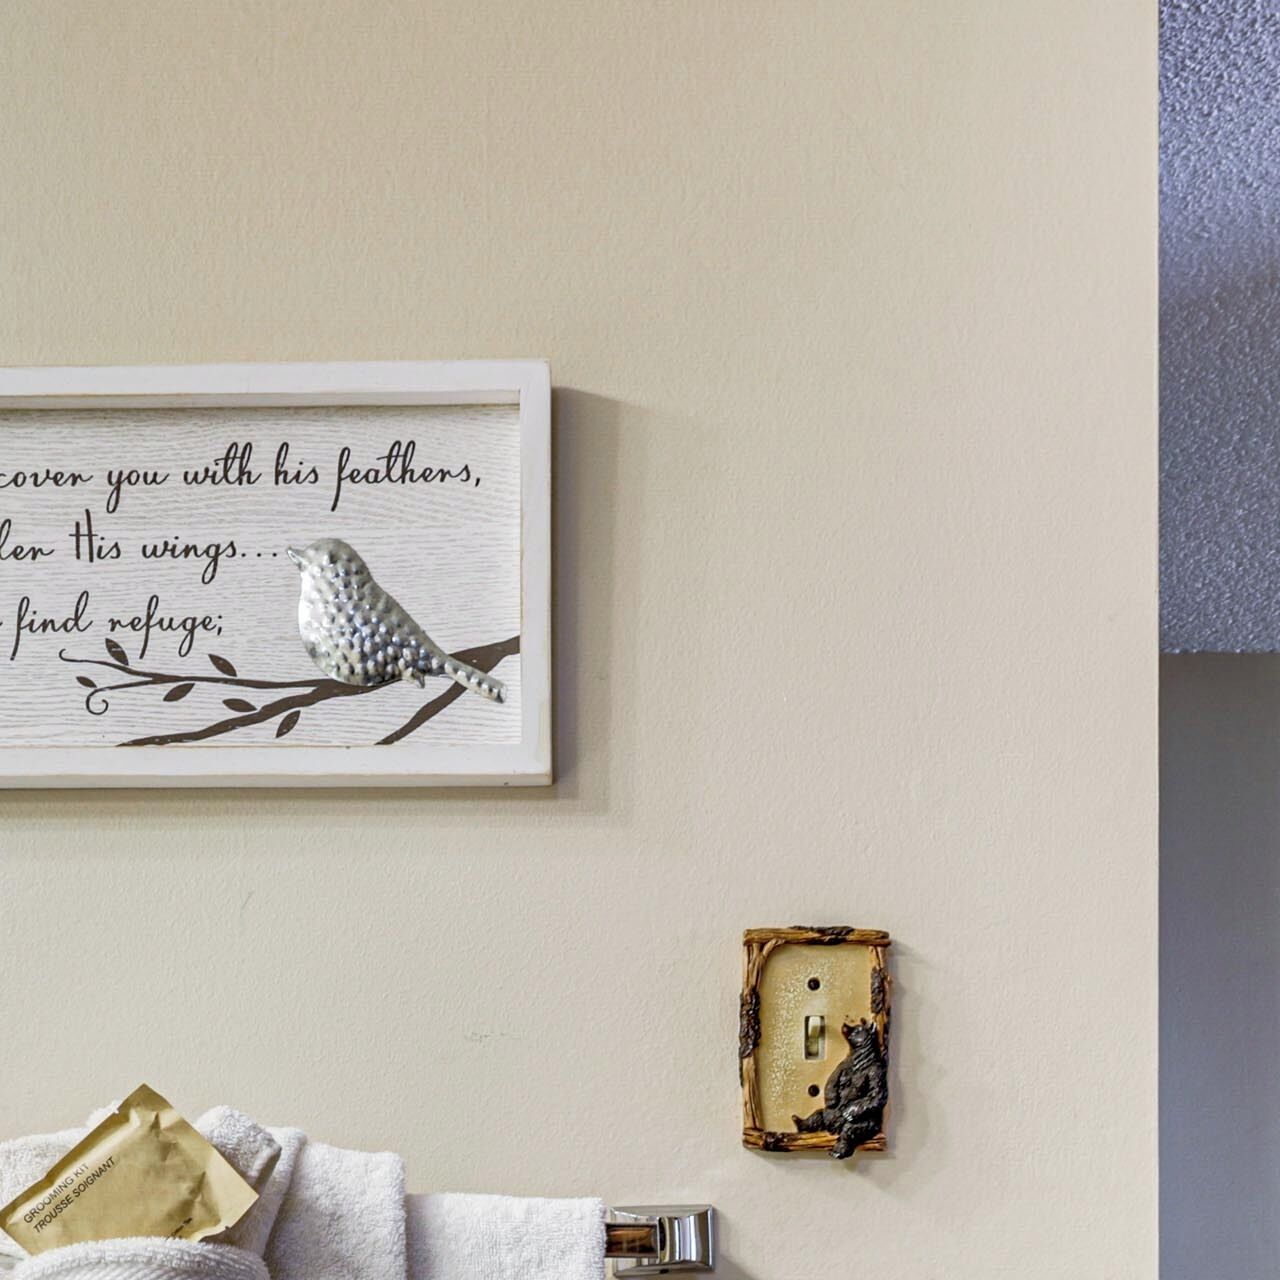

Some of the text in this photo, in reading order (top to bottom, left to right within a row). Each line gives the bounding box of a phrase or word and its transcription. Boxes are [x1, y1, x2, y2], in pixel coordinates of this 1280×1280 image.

[106, 468, 170, 514] you
[183, 440, 263, 487] with
[273, 440, 320, 487] his
[329, 440, 482, 512] feathers,
[68, 507, 122, 563] His
[9, 590, 95, 661] find
[107, 593, 224, 660] refuge;
[23, 1162, 90, 1224] GROOMING KIT
[33, 1156, 116, 1233] TROUSSE SOIGNANT
